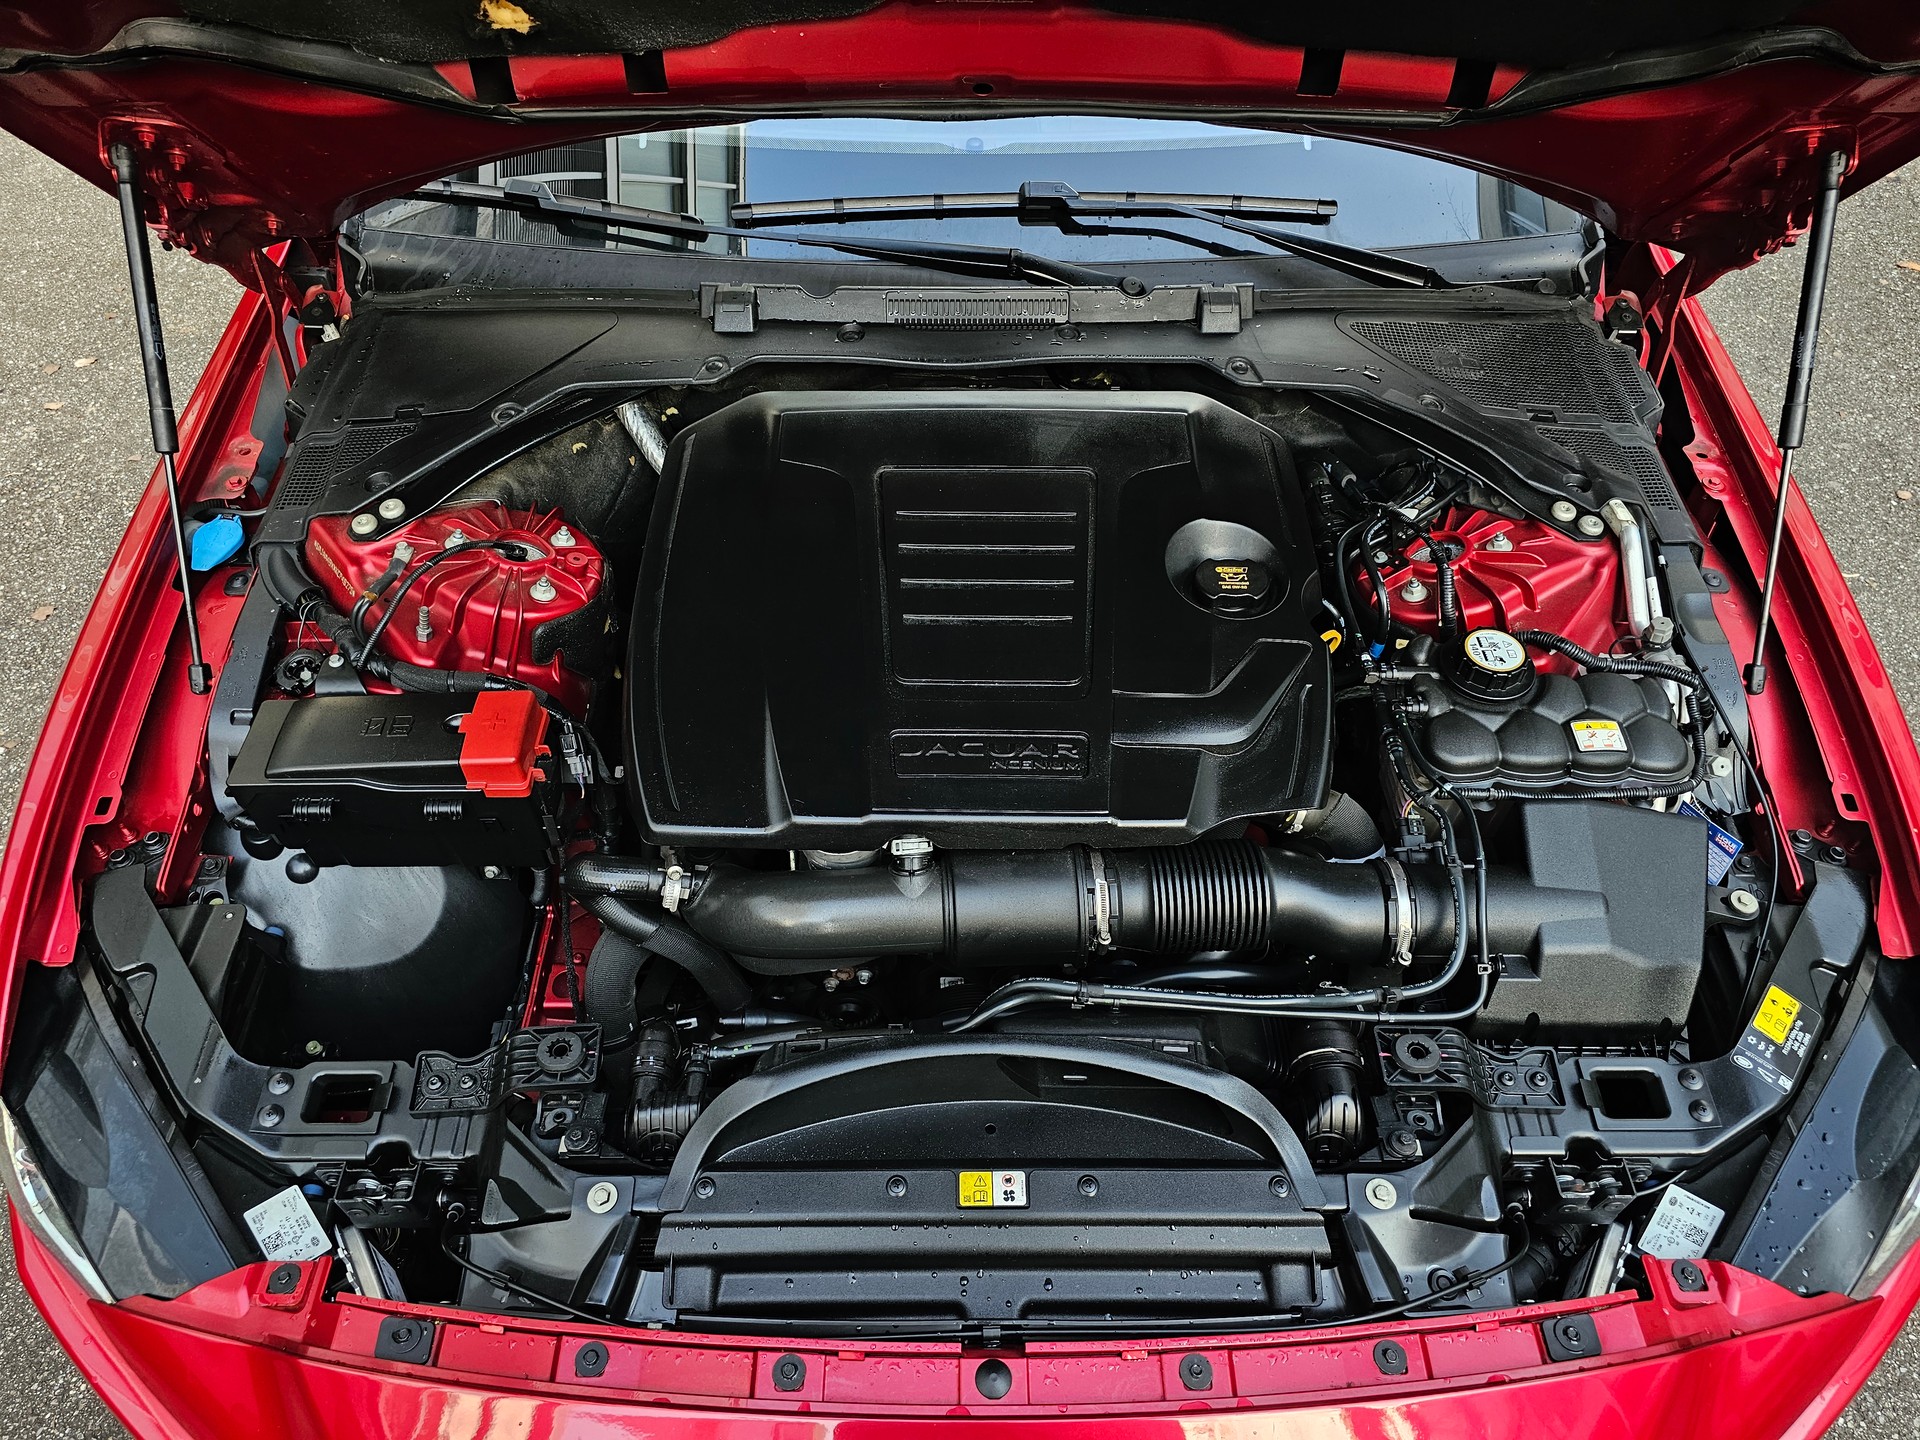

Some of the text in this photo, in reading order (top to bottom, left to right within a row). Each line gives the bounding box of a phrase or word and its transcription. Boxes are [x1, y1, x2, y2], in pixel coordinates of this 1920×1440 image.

[899, 743, 1080, 758] JAGUAR
[989, 760, 1084, 772] INGENIUM
[1714, 837, 1734, 854] MOLY
[1716, 832, 1736, 849] LIQUI
